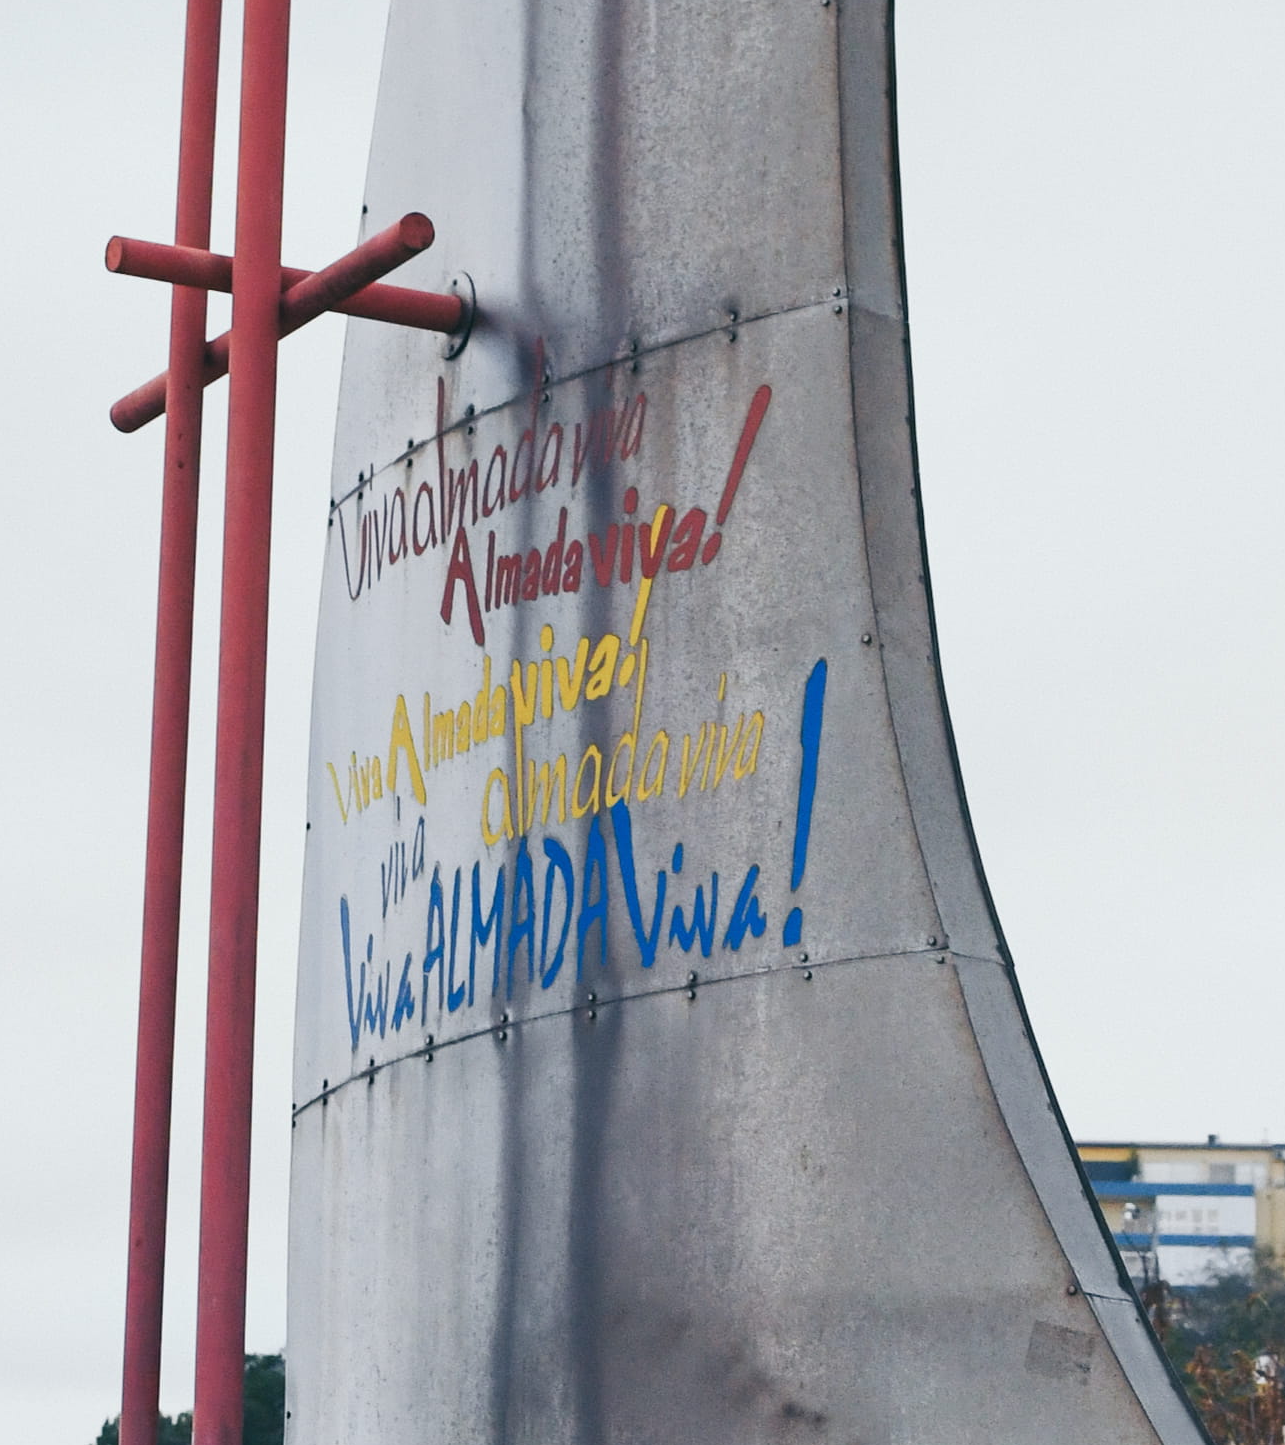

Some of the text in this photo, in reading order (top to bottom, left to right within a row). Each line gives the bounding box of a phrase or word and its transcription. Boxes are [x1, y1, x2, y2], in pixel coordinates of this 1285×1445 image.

[440, 506, 584, 646] Almada
[387, 655, 506, 806] Almada
[481, 638, 670, 845] almada
[340, 894, 416, 1053] Viva
[420, 815, 610, 1028] ALMADA
